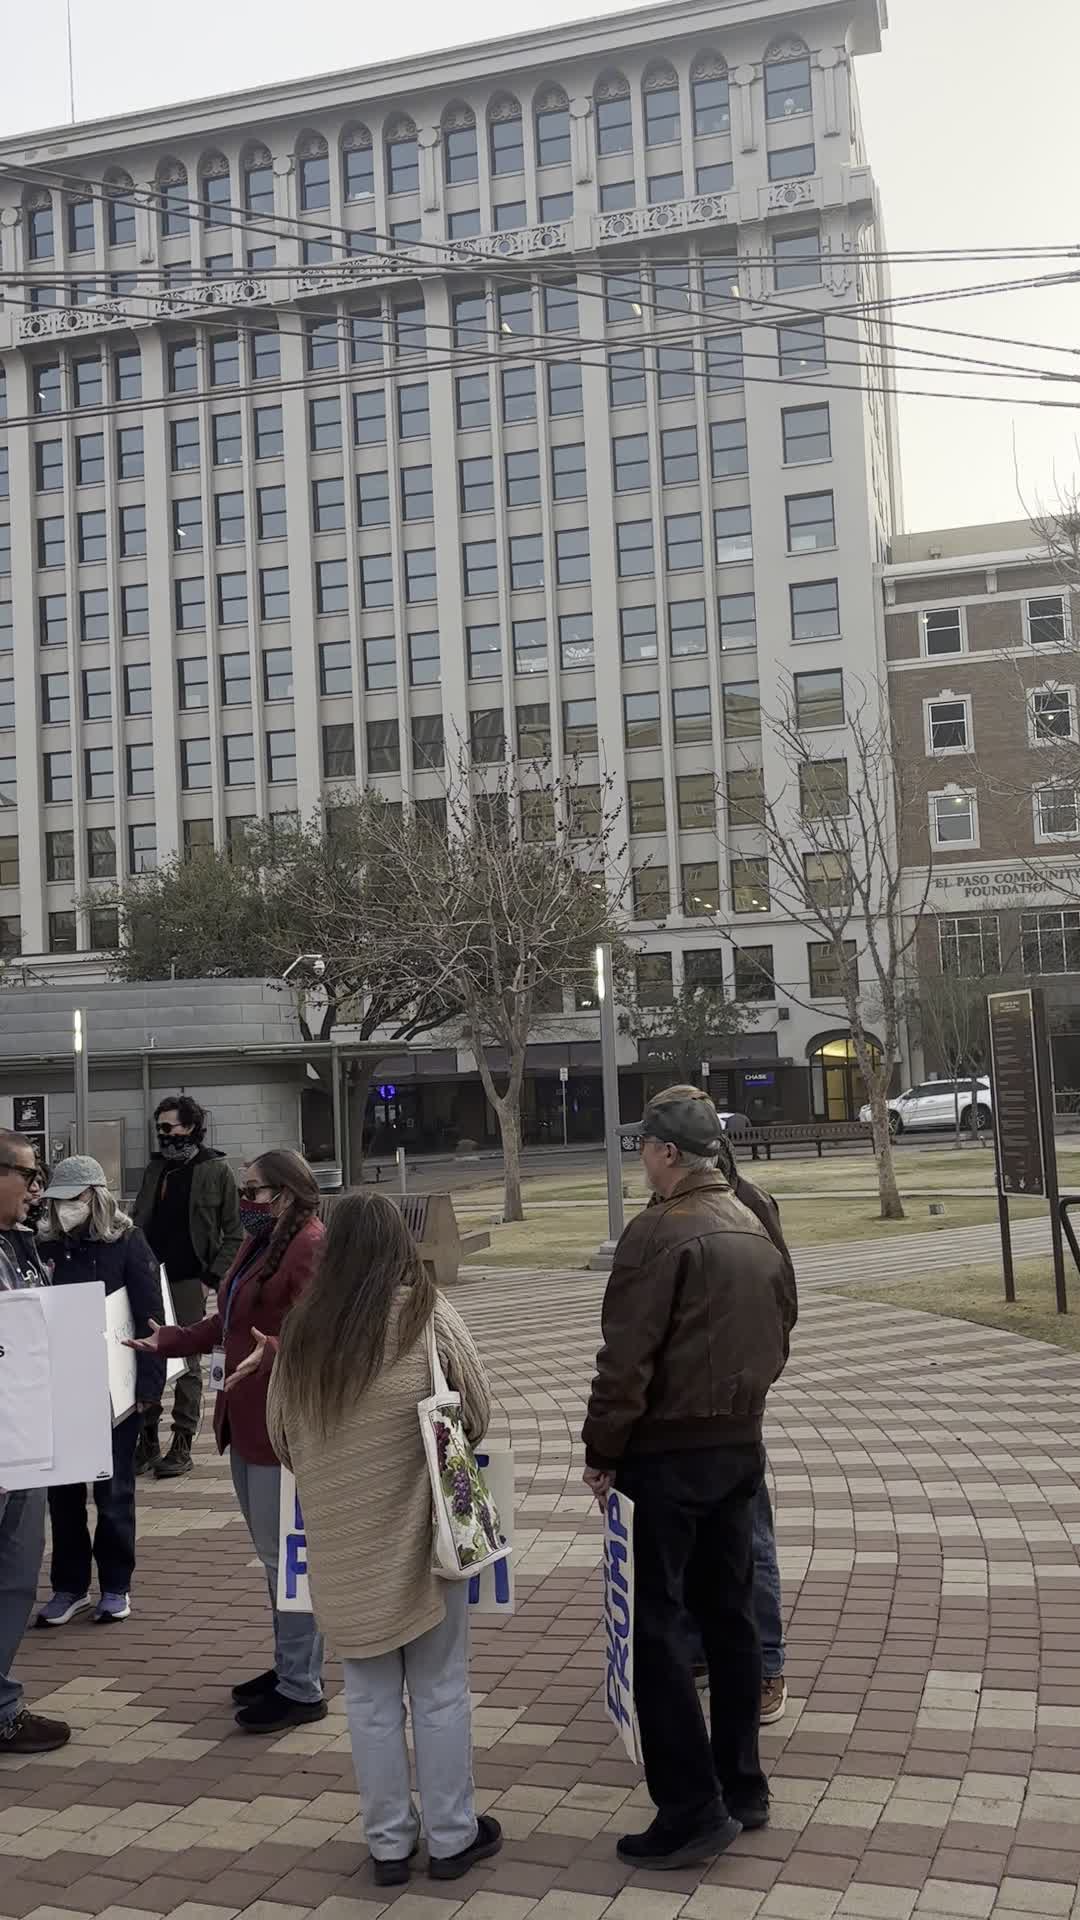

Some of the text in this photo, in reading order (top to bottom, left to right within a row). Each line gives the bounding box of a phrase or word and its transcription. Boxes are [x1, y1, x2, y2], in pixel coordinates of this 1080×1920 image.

[935, 868, 1080, 888] EL PASO COMMUNITY
[965, 882, 1053, 897] FOUNDATION
[607, 1493, 631, 1729] TRUMP
